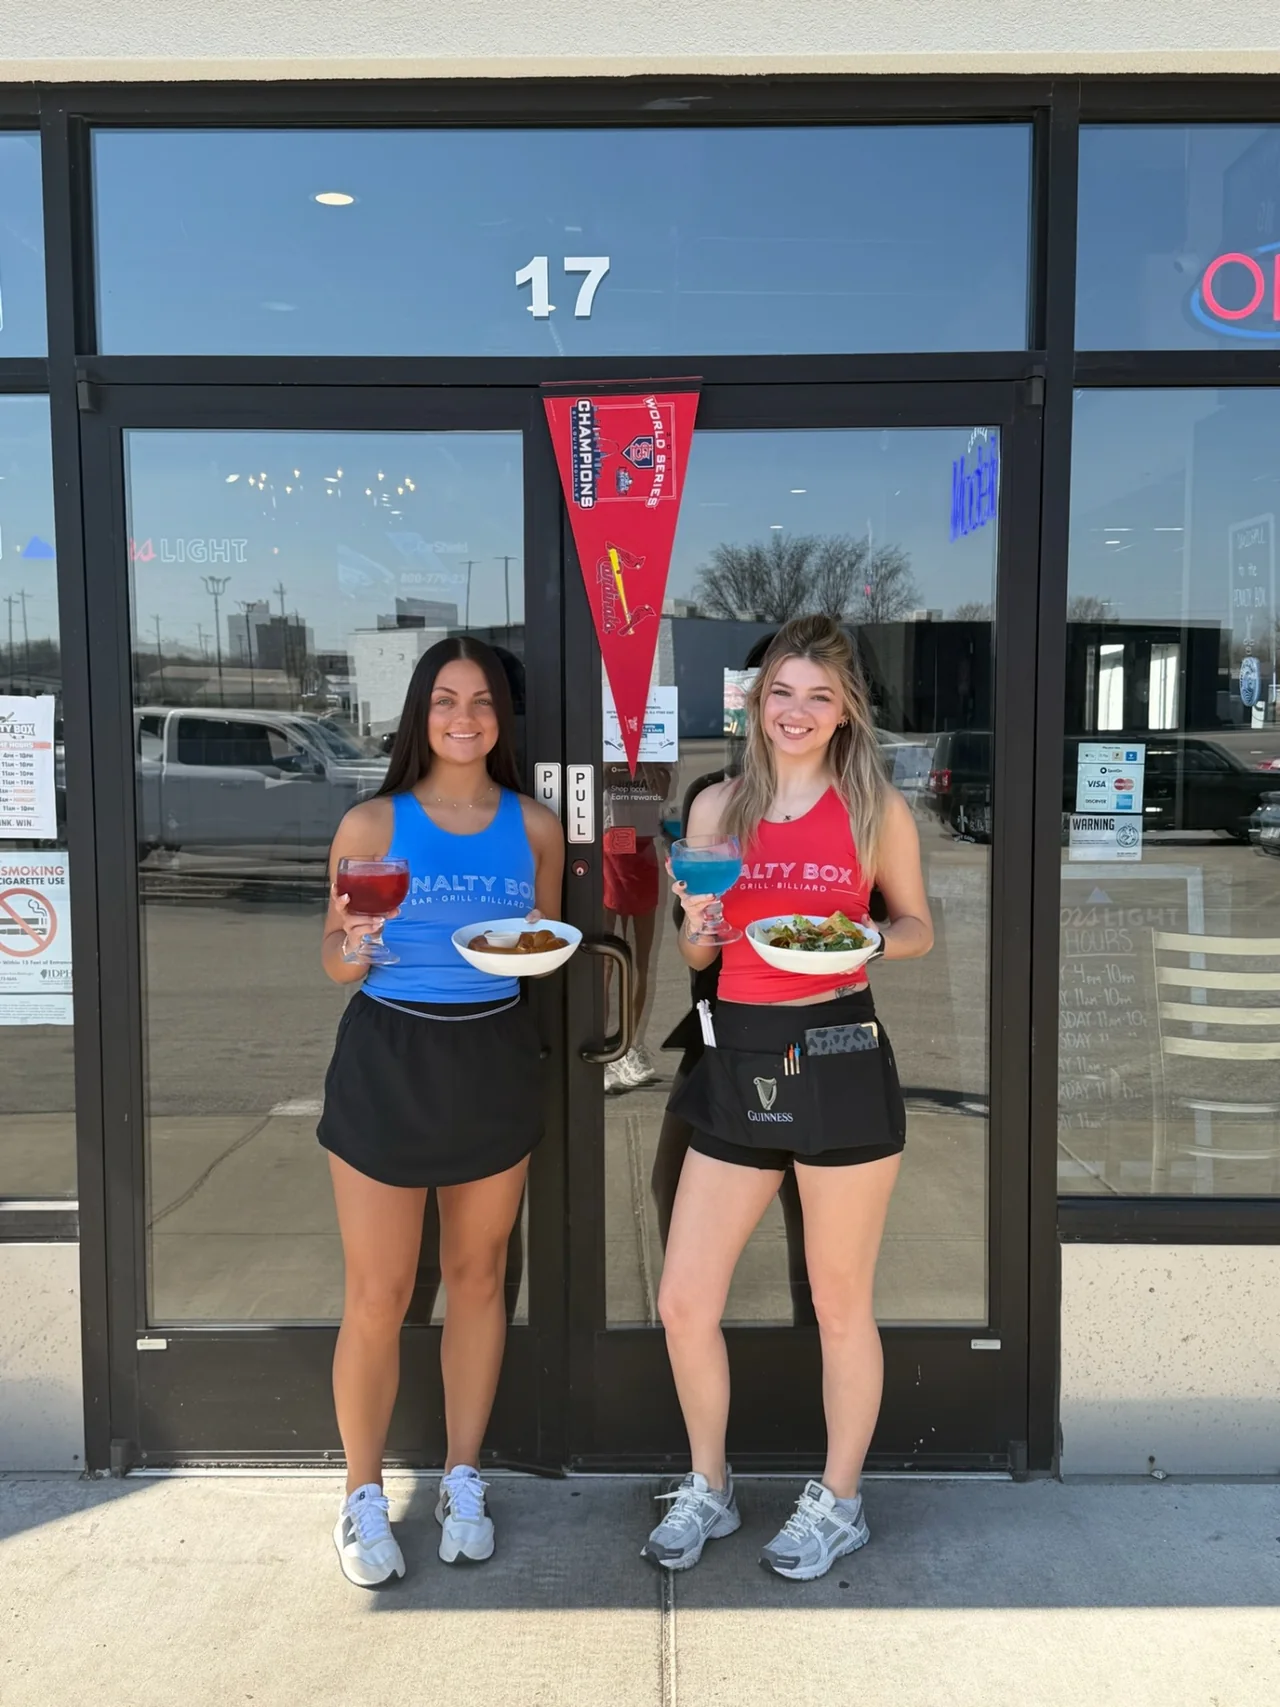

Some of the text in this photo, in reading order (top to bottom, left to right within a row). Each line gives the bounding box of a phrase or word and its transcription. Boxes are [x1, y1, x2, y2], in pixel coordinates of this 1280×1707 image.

[515, 256, 609, 316] 17
[577, 400, 594, 508] CHAMPIONS
[645, 397, 666, 507] WORLD SERIES
[160, 538, 248, 563] LIGHT
[14, 725, 34, 734] BOX
[1087, 780, 1106, 788] VISA
[575, 772, 586, 835] PULL
[611, 793, 664, 801] Earn rewards.
[1072, 818, 1115, 831] WARNING
[1, 866, 64, 876] SMOKING
[803, 862, 852, 885] BOX
[48, 877, 65, 885] USE
[408, 874, 535, 900] NALTY BO
[739, 882, 827, 893] GRILL BILLIARD
[411, 895, 525, 909] BAR GRILL BILLIARD
[1104, 908, 1179, 927] LIGHT
[1065, 928, 1134, 954] HOURS
[747, 1110, 794, 1122] GUINNESS
